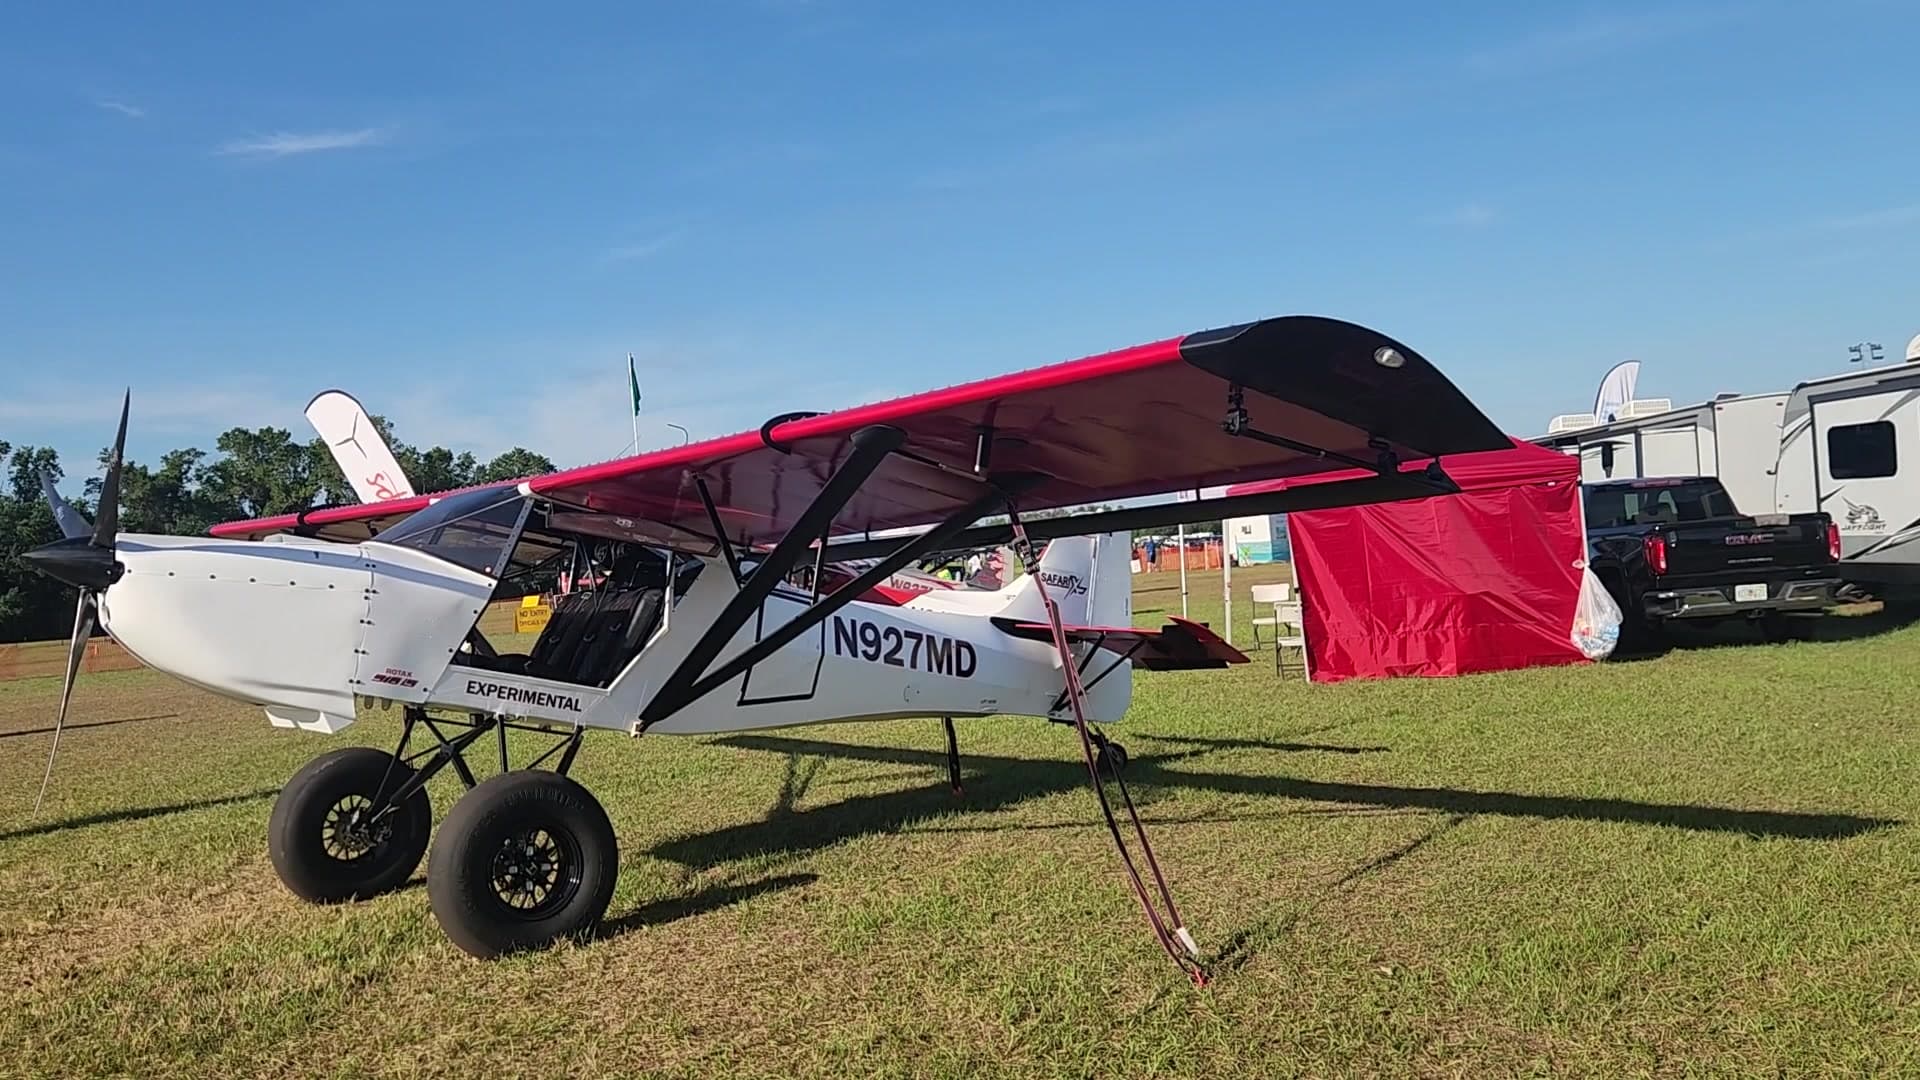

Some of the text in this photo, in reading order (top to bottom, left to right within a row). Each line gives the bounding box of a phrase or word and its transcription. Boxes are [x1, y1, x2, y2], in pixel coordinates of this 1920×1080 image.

[833, 615, 977, 678] N927MD
[385, 667, 413, 678] ROTAX
[466, 680, 582, 713] EXPERIMENTAL
